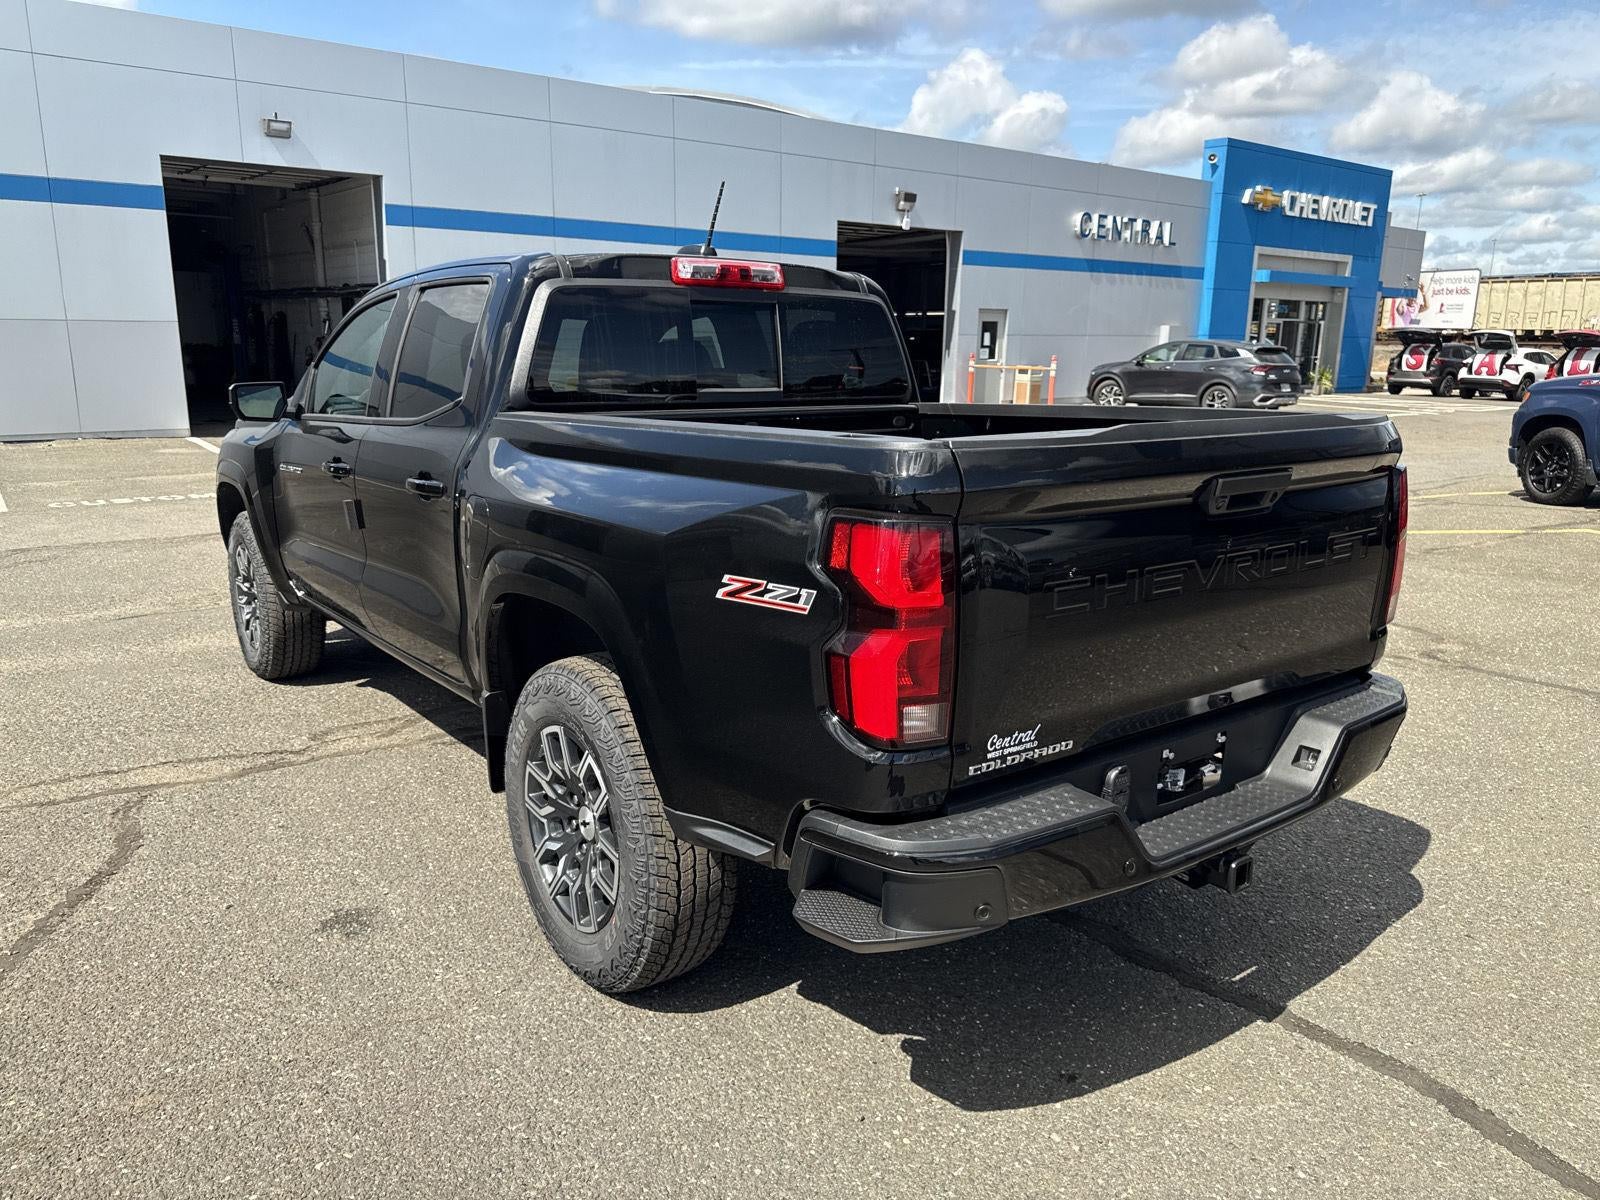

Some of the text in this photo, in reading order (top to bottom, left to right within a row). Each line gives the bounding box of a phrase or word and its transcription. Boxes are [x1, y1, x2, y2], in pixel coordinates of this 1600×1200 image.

[1282, 190, 1377, 227] CHEVROLET
[1074, 210, 1176, 247] CENTRAL
[1445, 287, 1454, 295] be
[1406, 344, 1431, 370] S
[1474, 350, 1498, 376] A
[1043, 527, 1379, 619] CHEVROLET
[715, 574, 818, 615] Z71
[986, 740, 1038, 760] WEST SPRINGFIELD
[987, 723, 1041, 751] Central
[968, 740, 1074, 776] COLORADO
